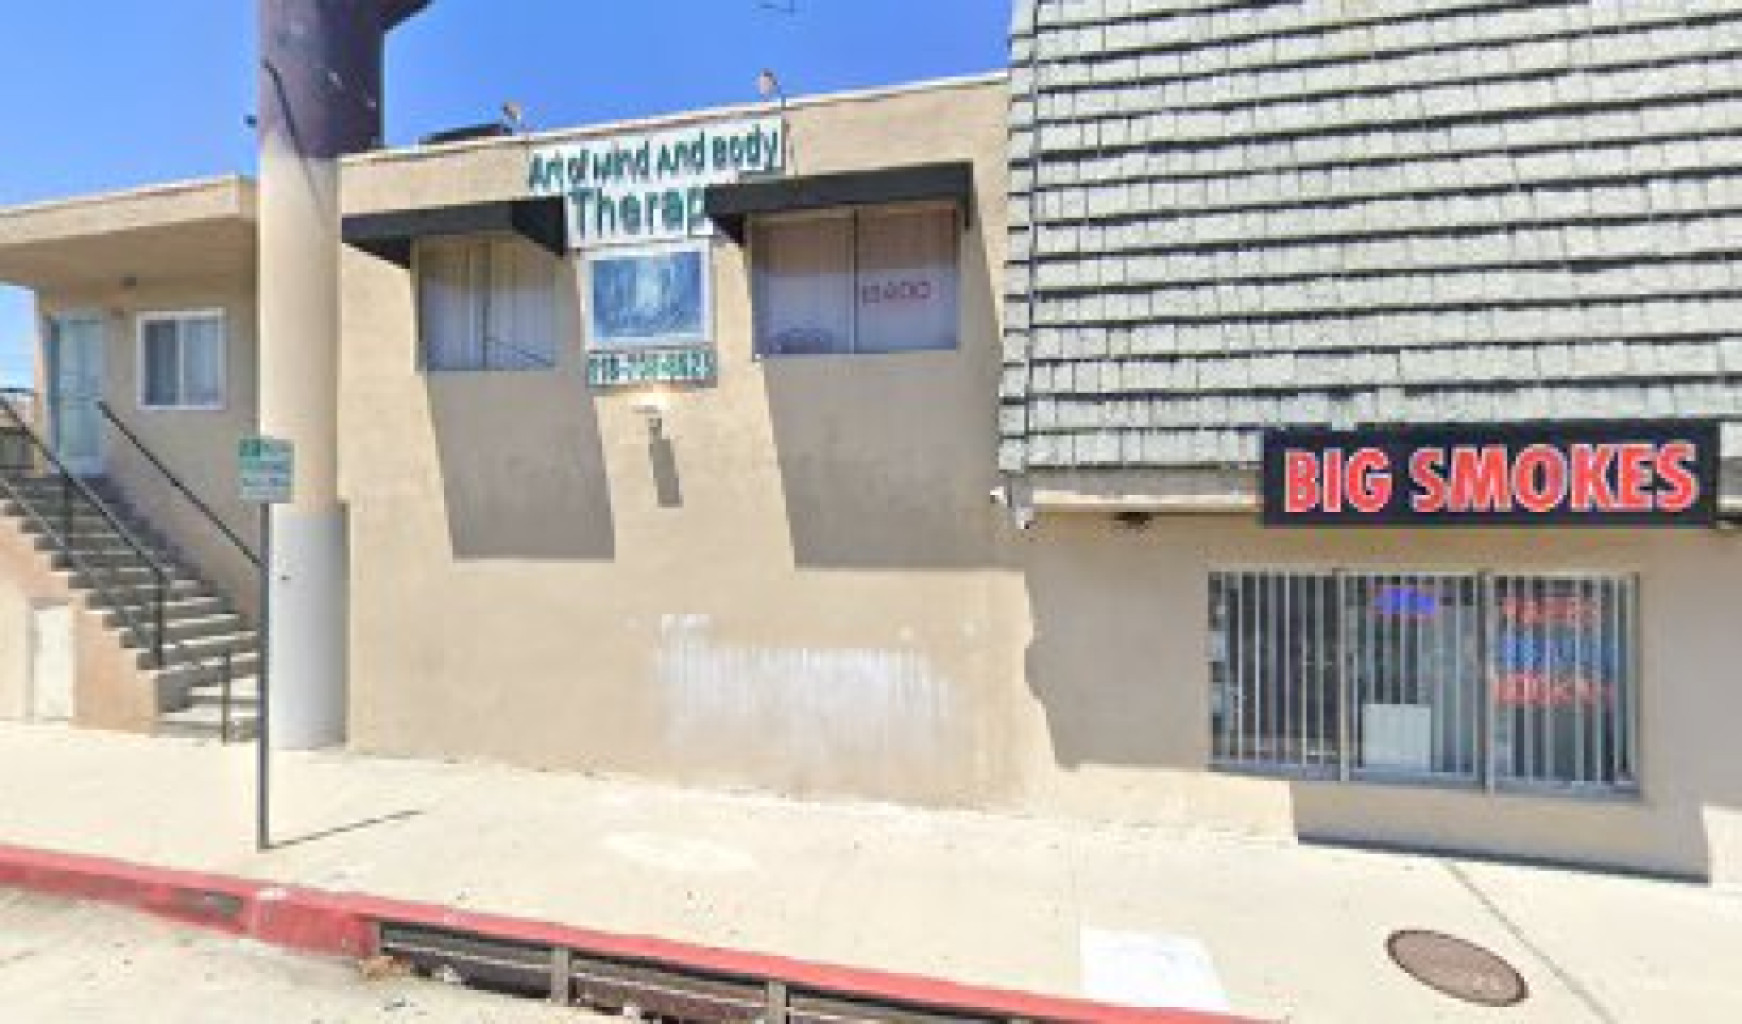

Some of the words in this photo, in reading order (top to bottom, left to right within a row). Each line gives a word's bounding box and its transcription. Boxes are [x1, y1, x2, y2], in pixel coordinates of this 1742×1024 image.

[568, 186, 706, 239] Therap
[1284, 446, 1394, 513] BIG
[1408, 442, 1699, 513] SMOKES
